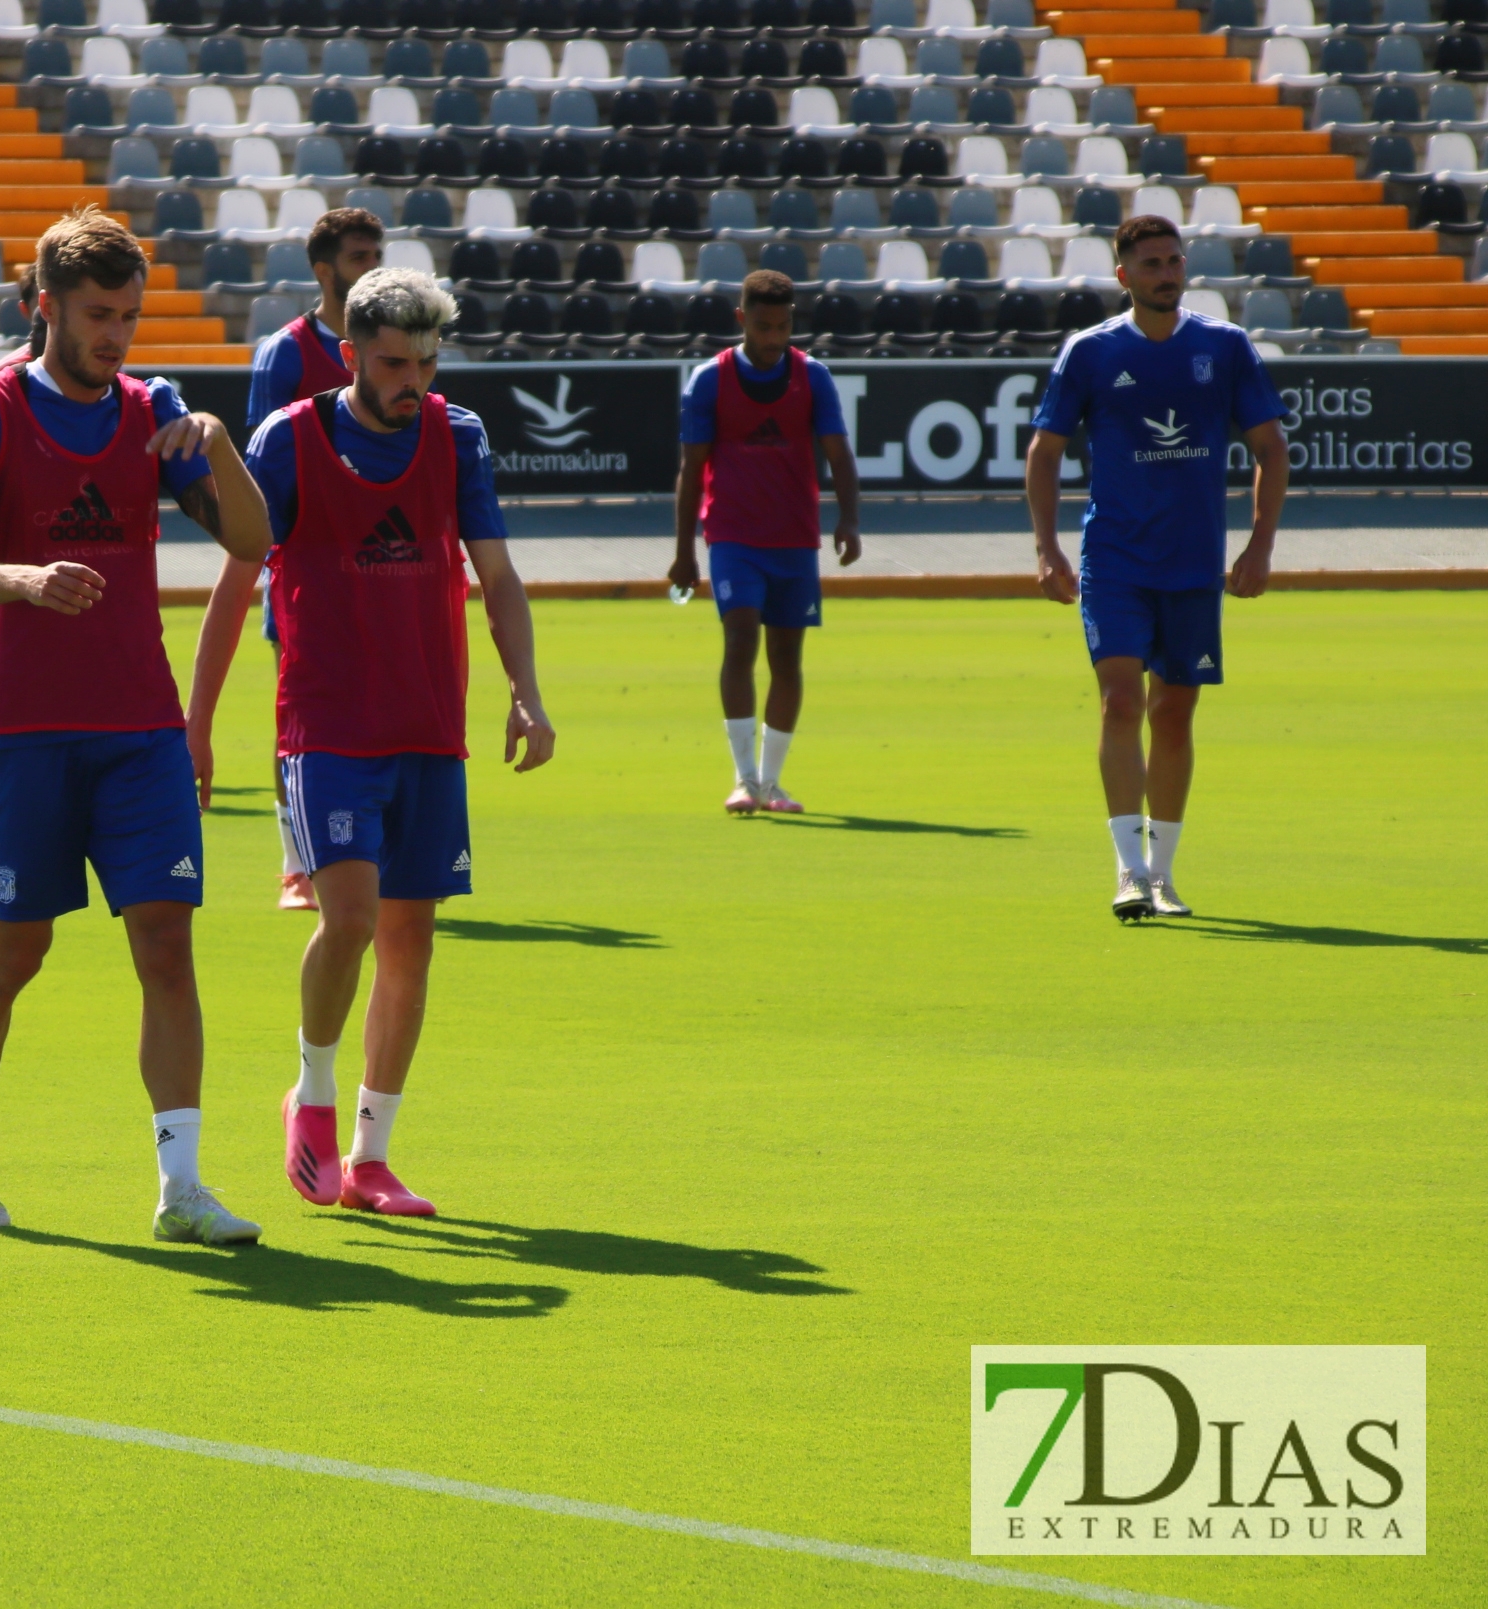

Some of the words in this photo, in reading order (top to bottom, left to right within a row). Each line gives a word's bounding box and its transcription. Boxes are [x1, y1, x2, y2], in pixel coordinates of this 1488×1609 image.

[1134, 446, 1210, 462] Extremadura
[49, 522, 125, 543] adidas
[340, 556, 437, 577] Extremadura
[170, 868, 198, 880] adidas
